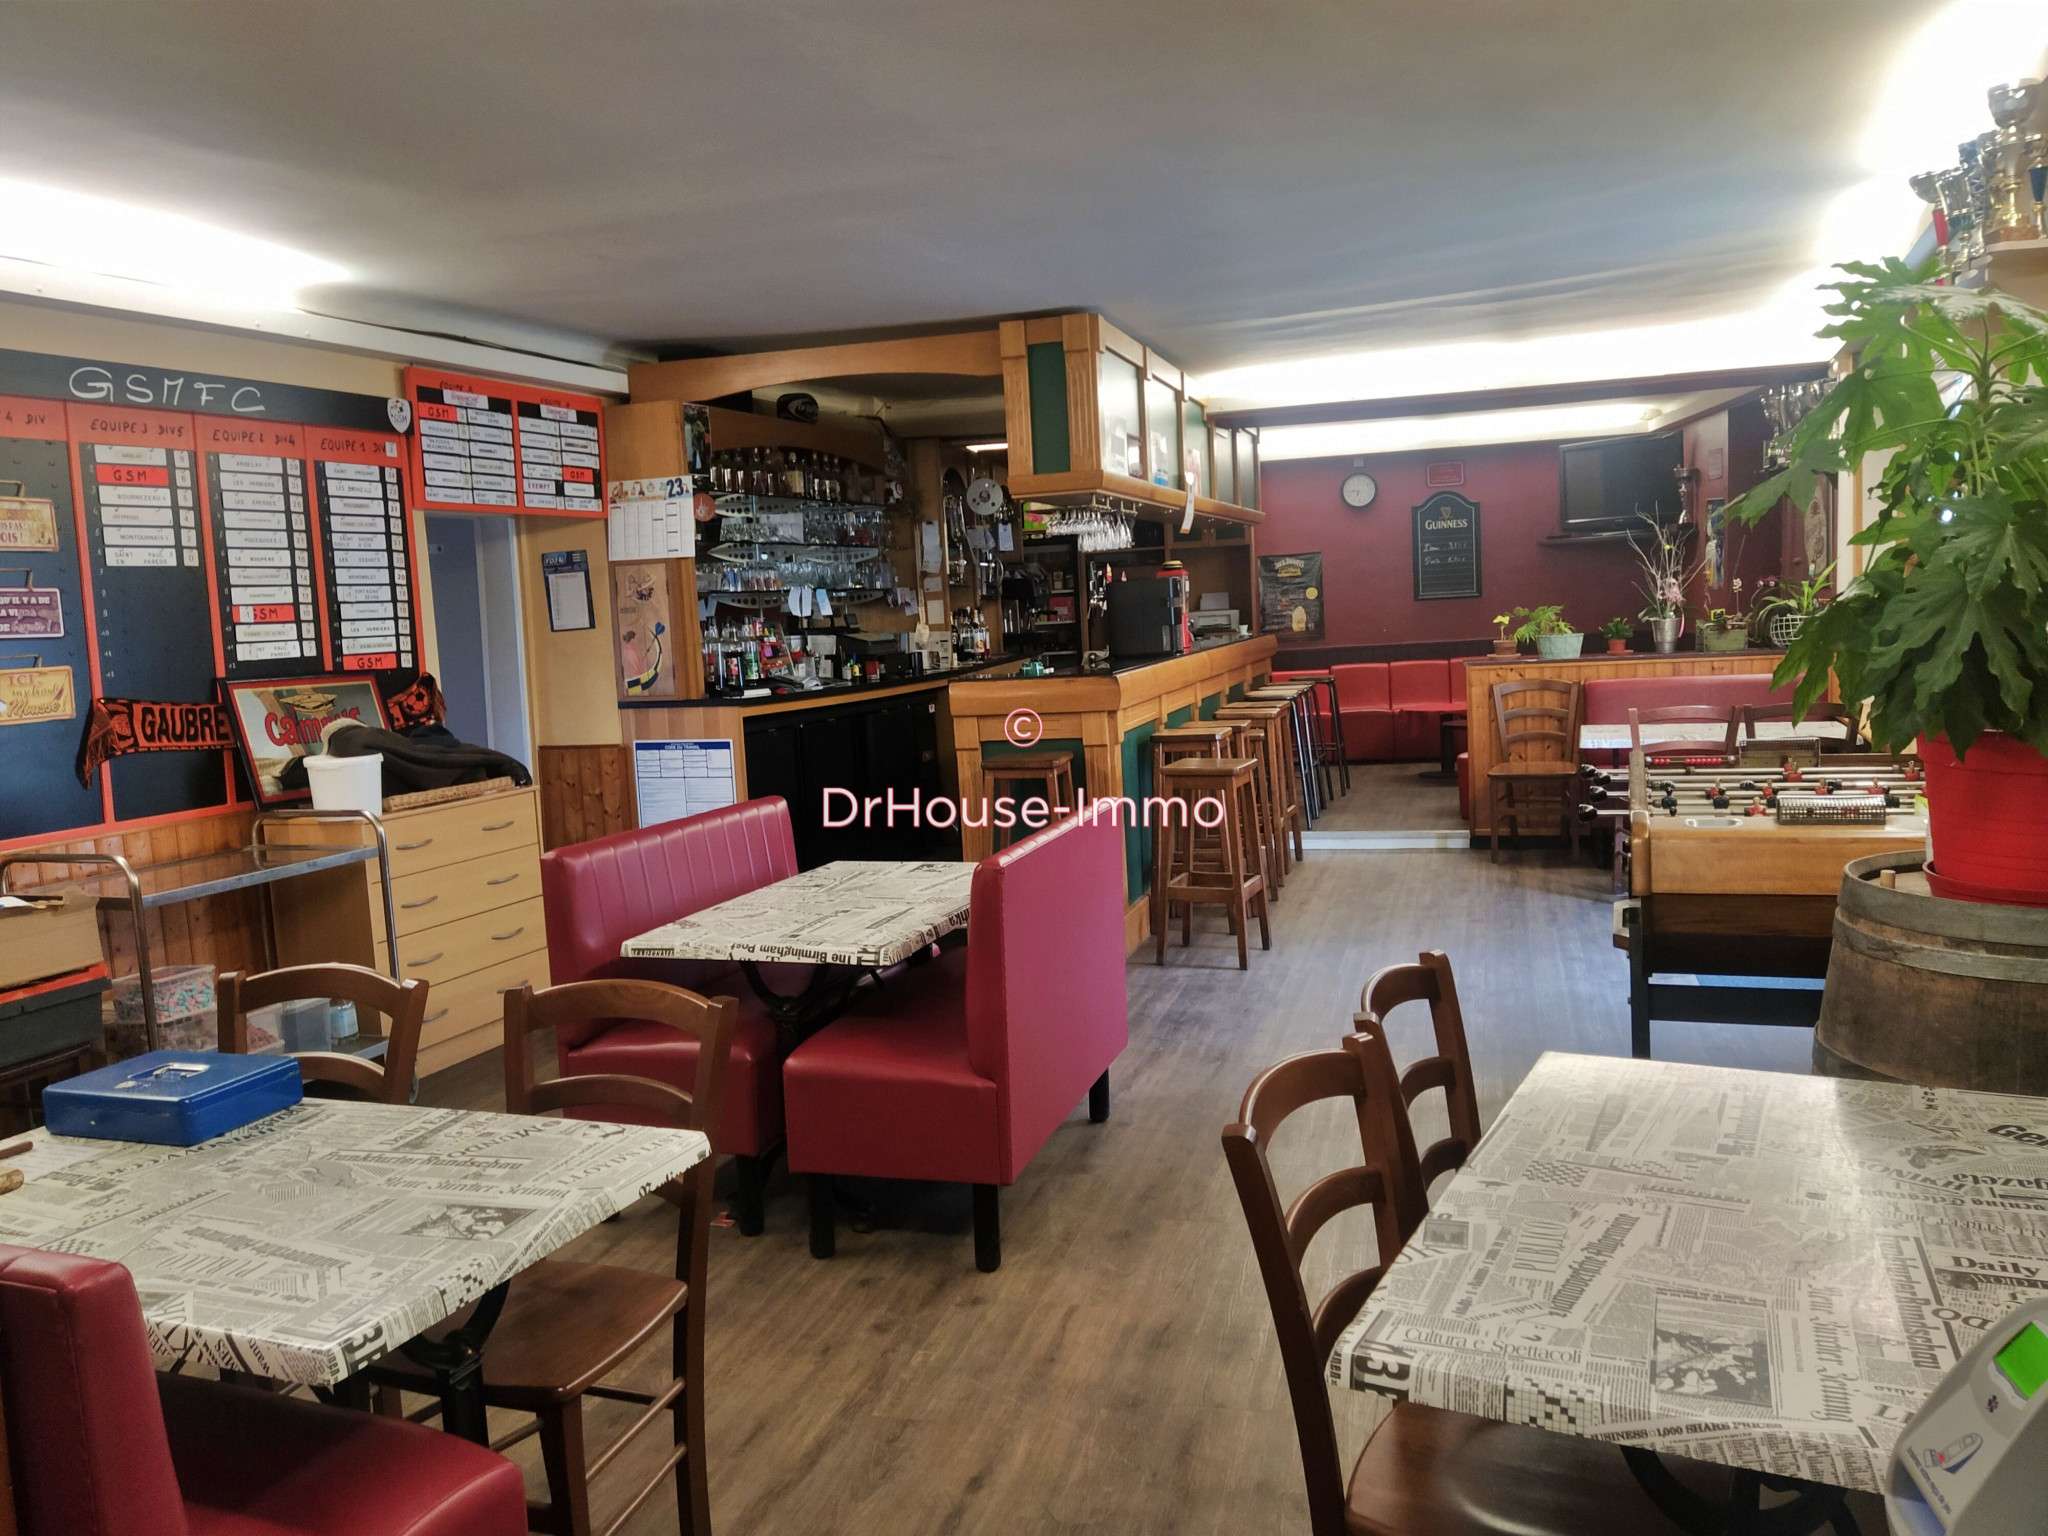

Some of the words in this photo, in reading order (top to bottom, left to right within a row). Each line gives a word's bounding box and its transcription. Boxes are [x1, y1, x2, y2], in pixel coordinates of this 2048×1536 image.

[90, 418, 137, 434] EQUIPE
[211, 429, 257, 443] EQUIPE
[320, 438, 357, 452] EQUIPE
[113, 469, 147, 482] GSM
[666, 477, 685, 499] 23
[1425, 519, 1468, 530] GUINNESS
[356, 656, 383, 669] GSM
[758, 943, 829, 964] Birmingham
[1951, 1255, 2041, 1278] Daily
[1405, 1327, 1468, 1350] Cultura
[1492, 1340, 1582, 1365] Spettacoli
